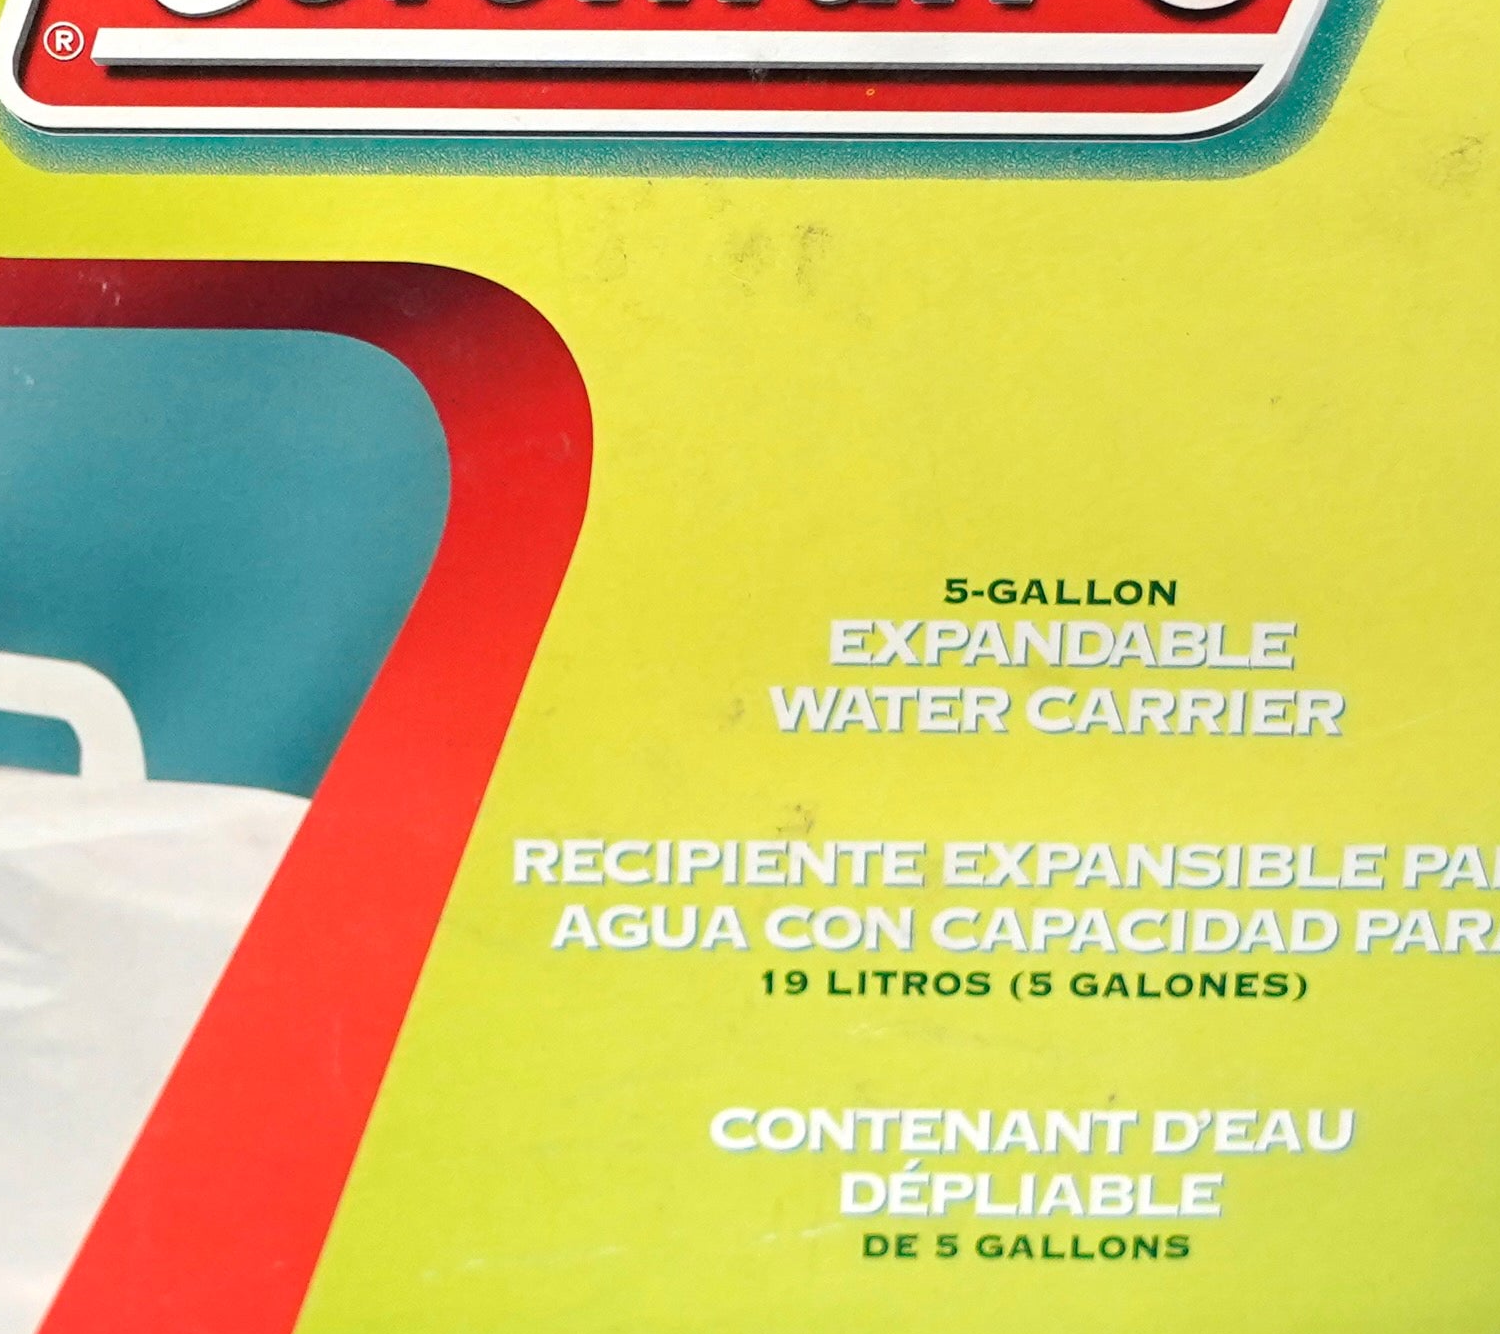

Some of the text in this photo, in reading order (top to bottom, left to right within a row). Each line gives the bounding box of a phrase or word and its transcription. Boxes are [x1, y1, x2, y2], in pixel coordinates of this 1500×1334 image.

[943, 577, 1179, 608] 5-GALLON
[828, 620, 1297, 671] EXPANDABLE
[770, 686, 1346, 737] WATER CARRIER
[512, 838, 925, 887] RECIPIENTE
[940, 839, 1388, 891] EXPANSIBLE
[549, 906, 749, 953] AGUA
[763, 906, 915, 954] CON
[930, 908, 1340, 955] CAPACIDAD
[760, 969, 1309, 1002] 19 LITROS (5 GALONES)
[708, 1108, 1356, 1155] CONTENANT D'EAU
[838, 1166, 1224, 1218] DÉPLIABLE
[861, 1234, 1192, 1261] DE 5 GALLONS
